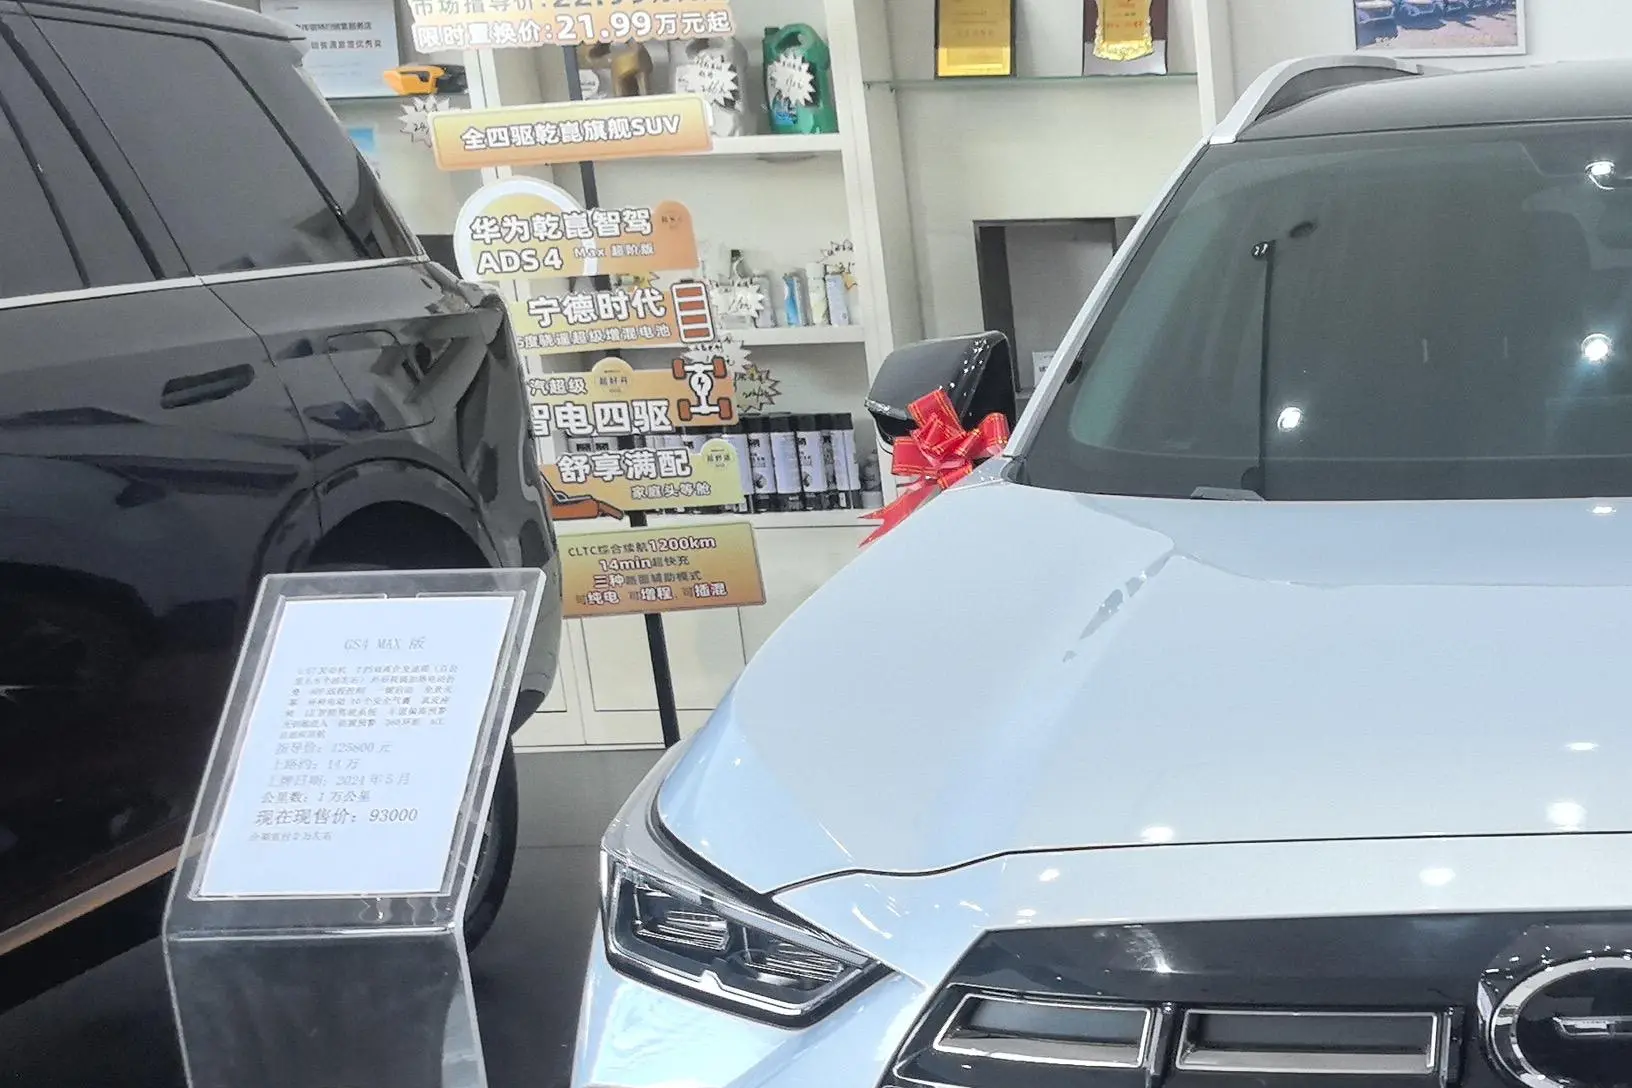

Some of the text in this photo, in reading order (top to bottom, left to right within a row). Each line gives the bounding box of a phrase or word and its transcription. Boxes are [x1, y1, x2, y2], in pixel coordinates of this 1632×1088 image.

[527, 286, 667, 329] 宁德时代
[557, 448, 693, 483] 舒享满配
